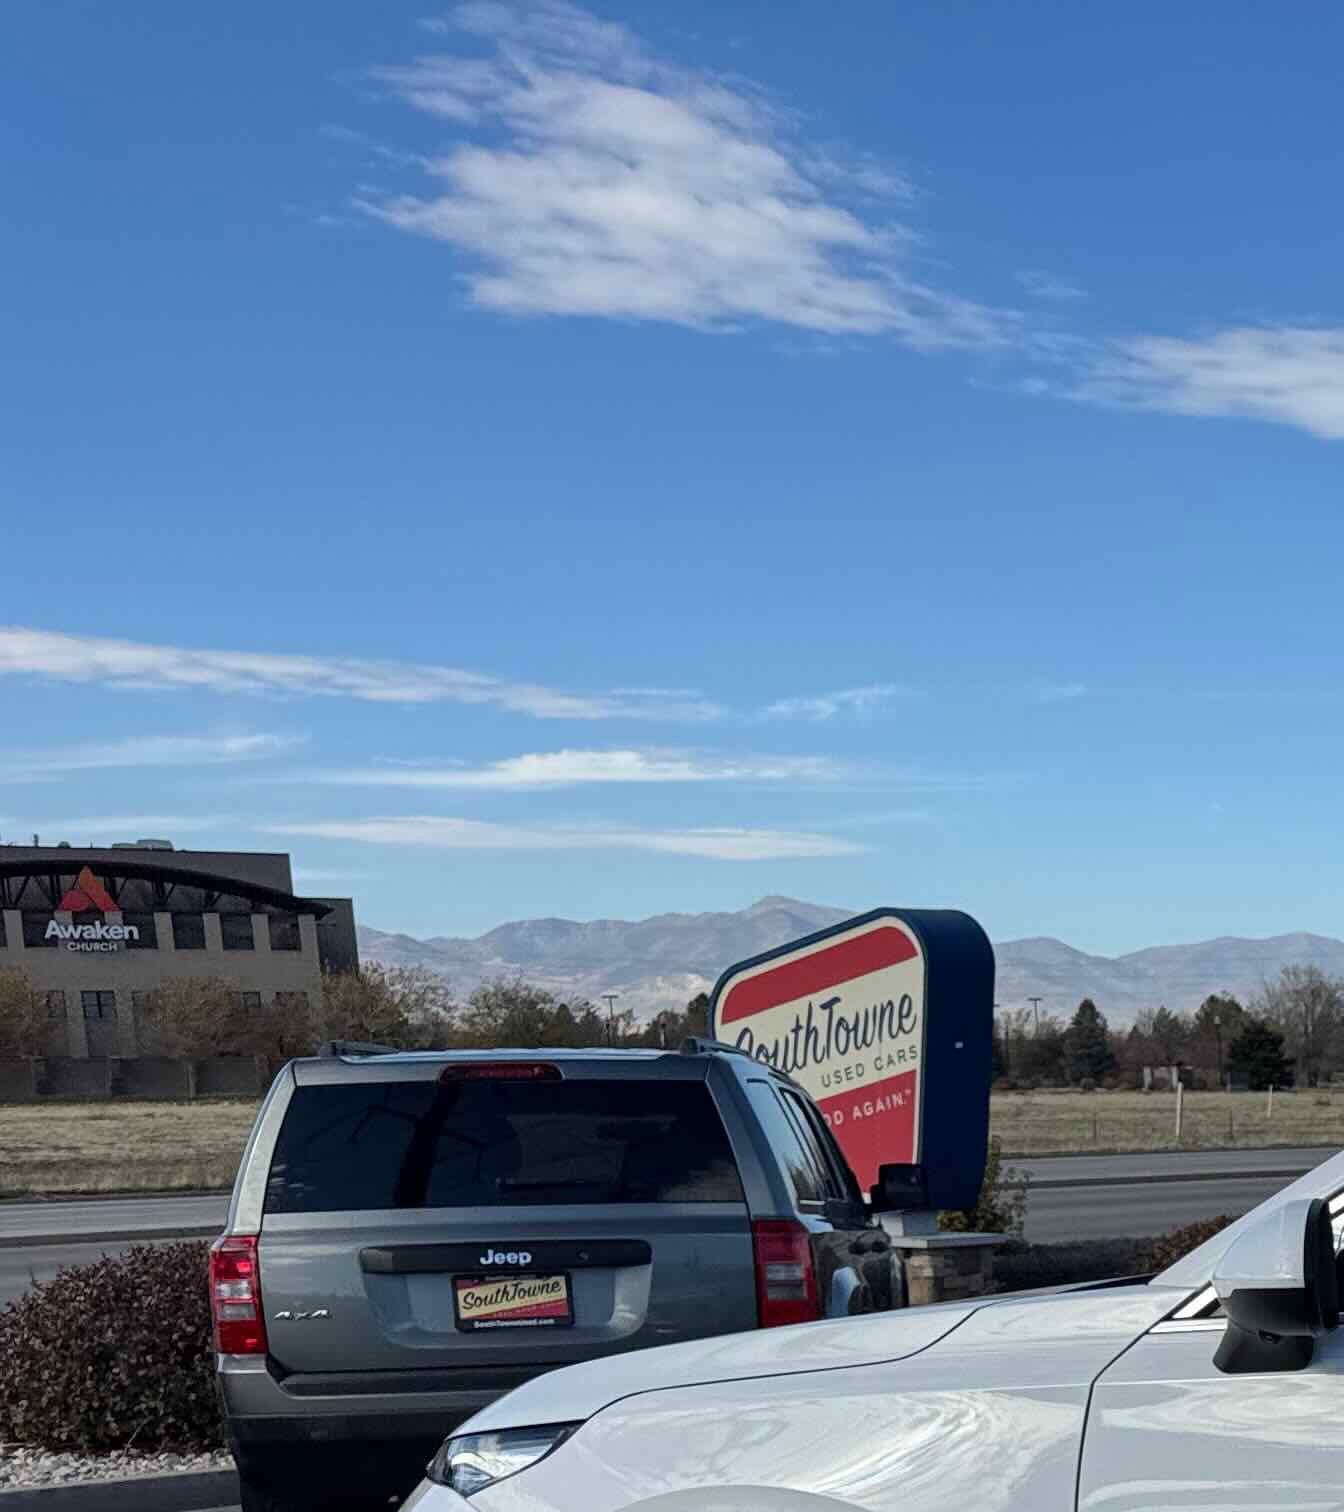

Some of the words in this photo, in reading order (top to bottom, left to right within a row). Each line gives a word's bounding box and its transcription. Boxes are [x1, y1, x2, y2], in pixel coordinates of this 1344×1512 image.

[44, 919, 140, 940] Awaken
[67, 942, 119, 952] CHURCH
[822, 1063, 865, 1088] USED
[873, 1045, 918, 1071] CARS
[480, 1249, 532, 1267] Jeep
[462, 1280, 562, 1310] SouthTowne
